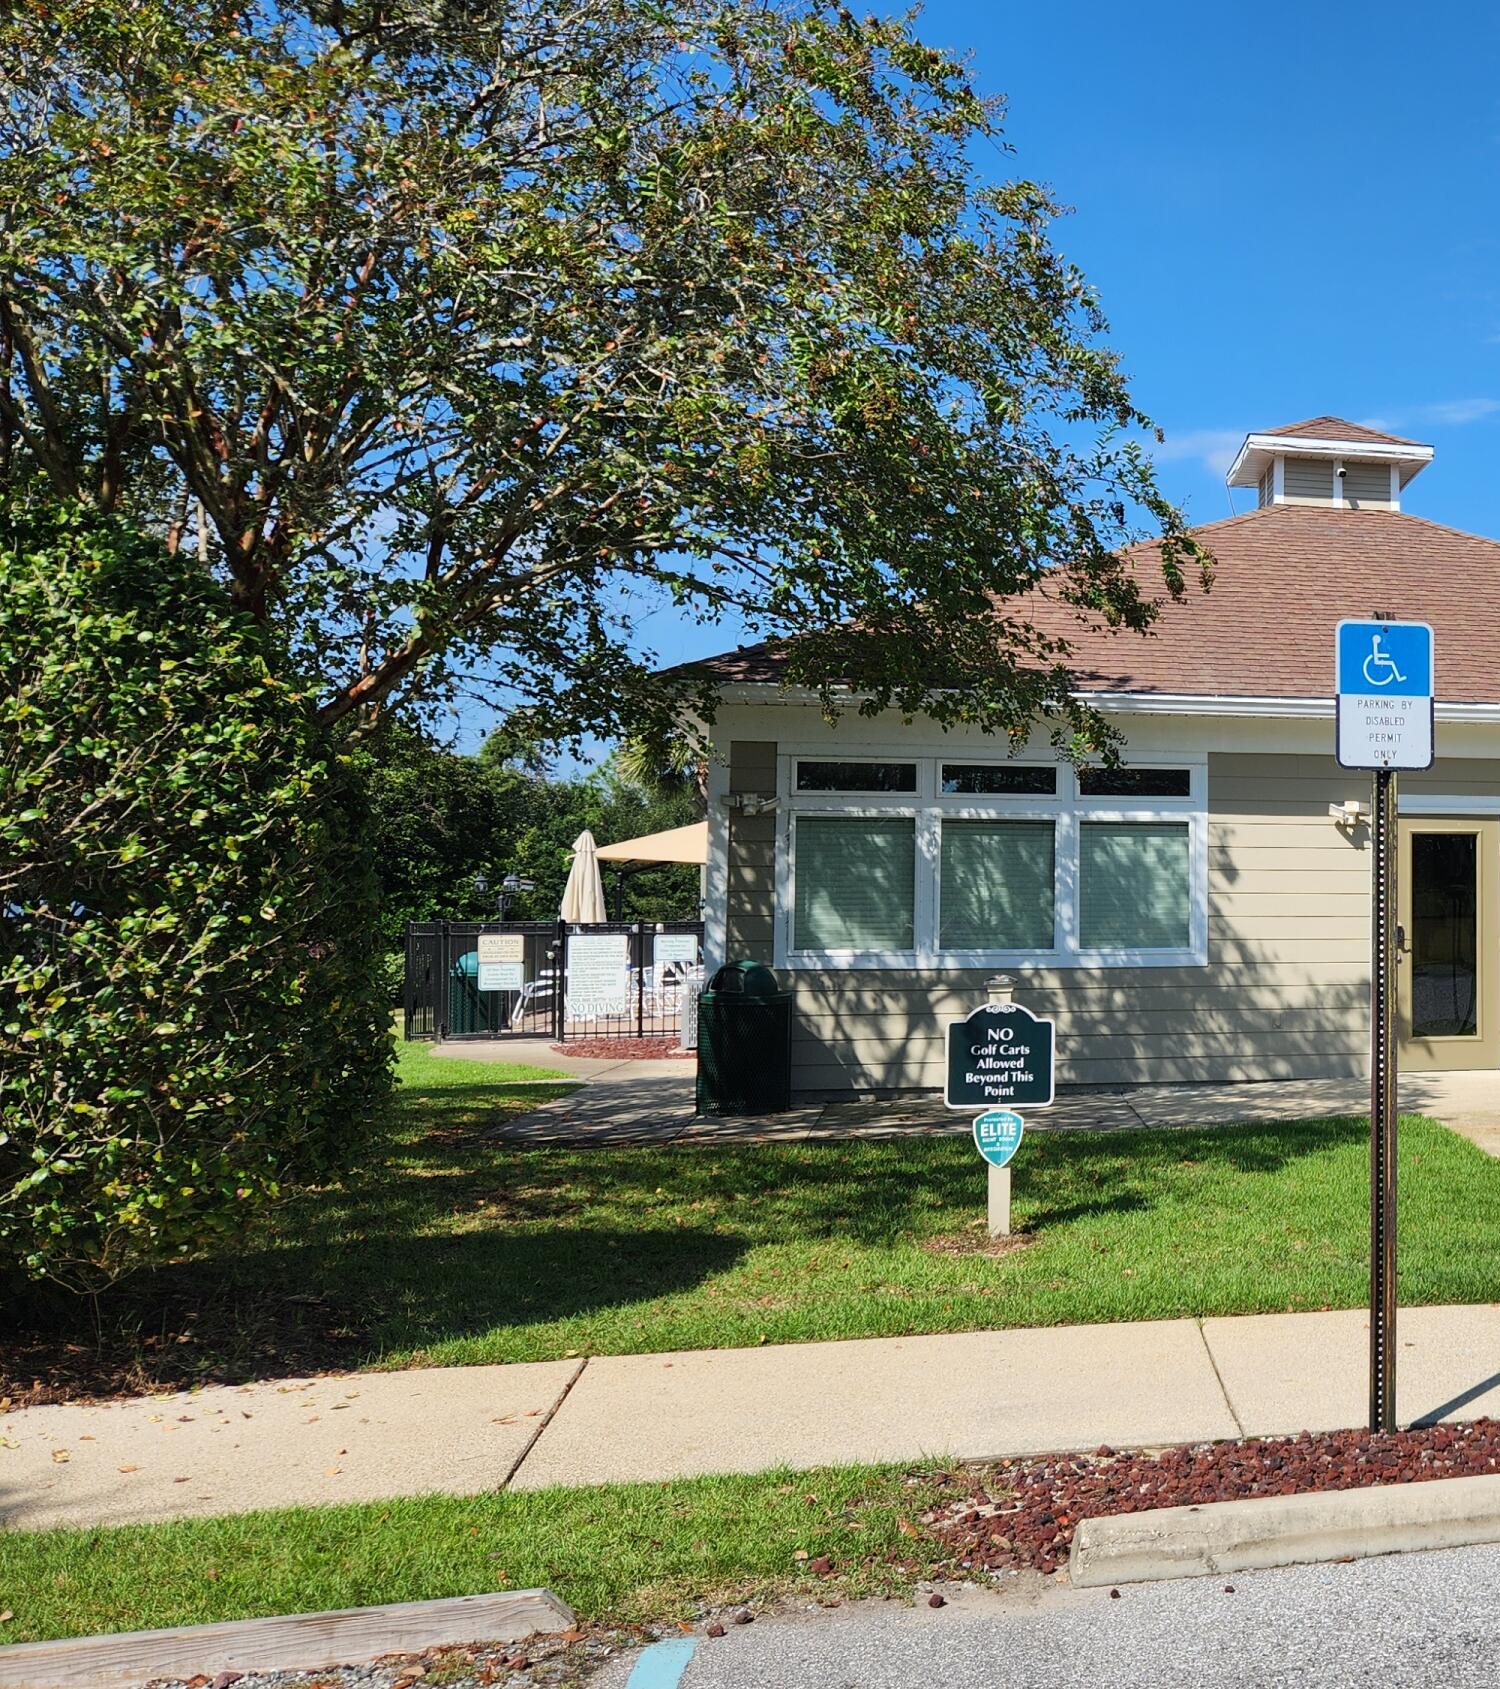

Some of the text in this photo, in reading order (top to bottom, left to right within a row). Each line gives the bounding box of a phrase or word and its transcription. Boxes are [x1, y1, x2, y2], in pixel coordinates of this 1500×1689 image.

[1357, 699, 1413, 710] PARKING BY
[1365, 716, 1405, 726] DISABLED
[1369, 733, 1402, 743] PERMIT
[1374, 750, 1398, 759] ONLY
[570, 1002, 624, 1013] NO DIVING
[987, 1027, 1014, 1041] NO
[970, 1044, 1031, 1056] Golf Carts
[976, 1057, 1025, 1069] Allowed
[965, 1070, 1034, 1086] Beyond This
[984, 1084, 1015, 1097] Point
[980, 1122, 1017, 1137] ELITE
